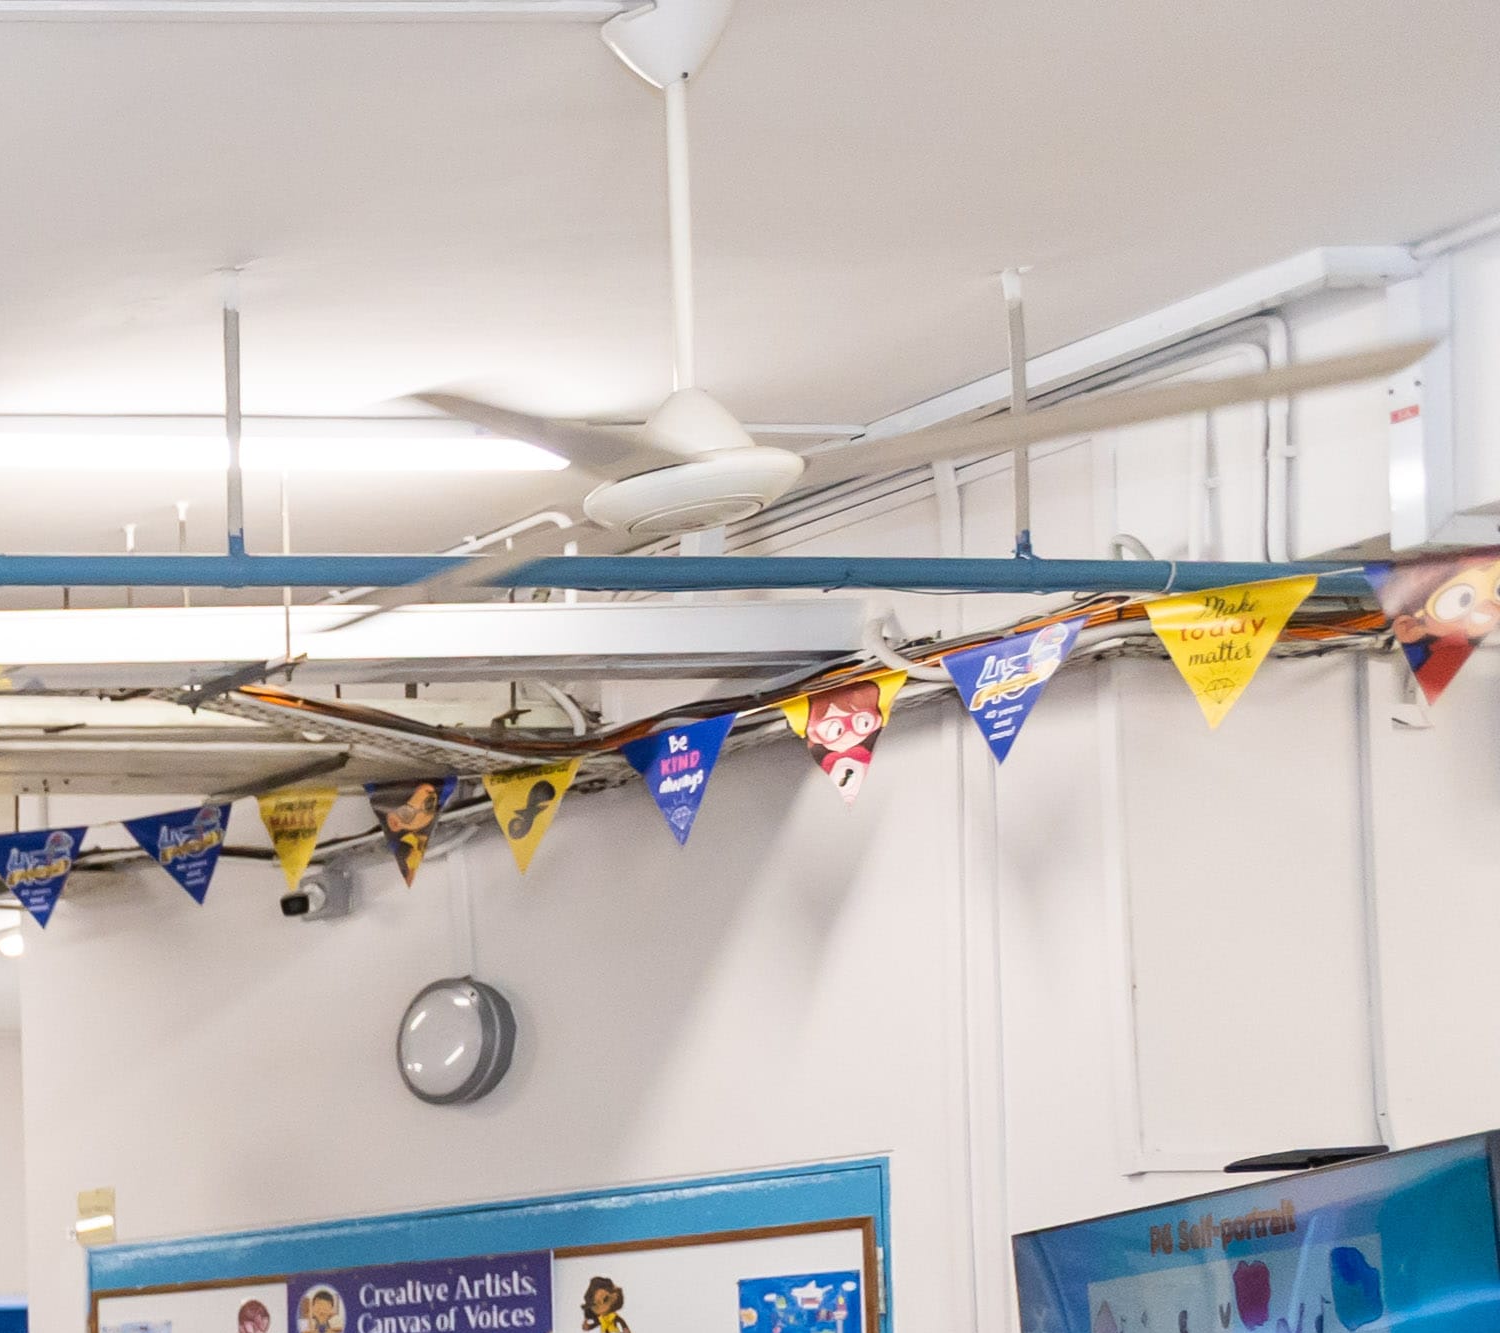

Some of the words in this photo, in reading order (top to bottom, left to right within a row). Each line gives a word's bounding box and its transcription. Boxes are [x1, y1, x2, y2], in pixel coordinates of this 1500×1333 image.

[1198, 591, 1258, 619] Make
[1189, 640, 1252, 667] matter
[660, 750, 701, 776] KIND
[659, 769, 704, 793] always
[1178, 1200, 1296, 1252] Self-portrait
[359, 1279, 449, 1309] Creative
[435, 1305, 460, 1332] of
[464, 1304, 536, 1330] Voices
